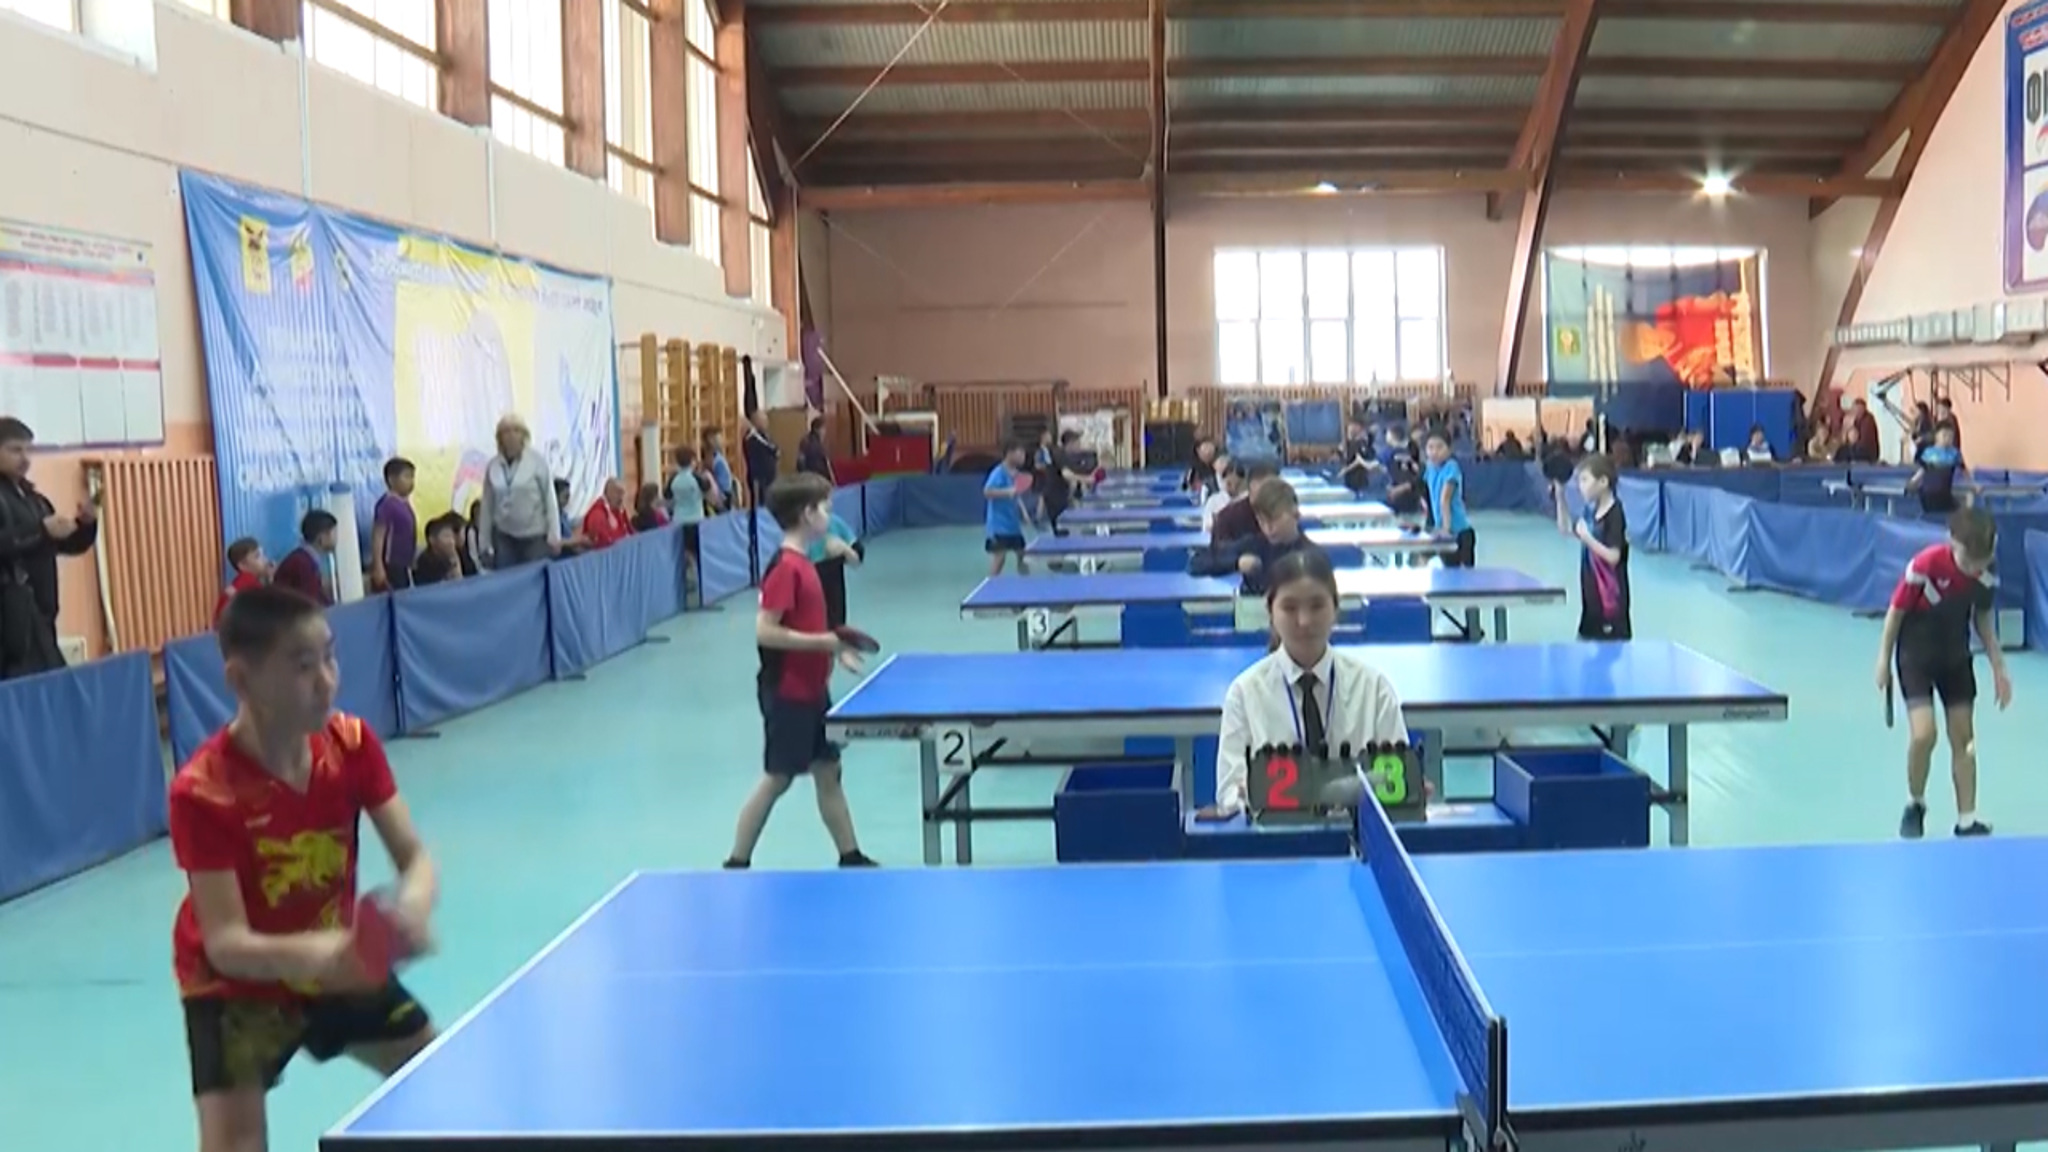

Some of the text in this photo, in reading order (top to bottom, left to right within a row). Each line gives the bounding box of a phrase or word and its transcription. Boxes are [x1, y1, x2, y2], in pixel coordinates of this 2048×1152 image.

[1032, 611, 1047, 635] 3
[943, 729, 965, 766] 2
[1266, 756, 1299, 808] 2
